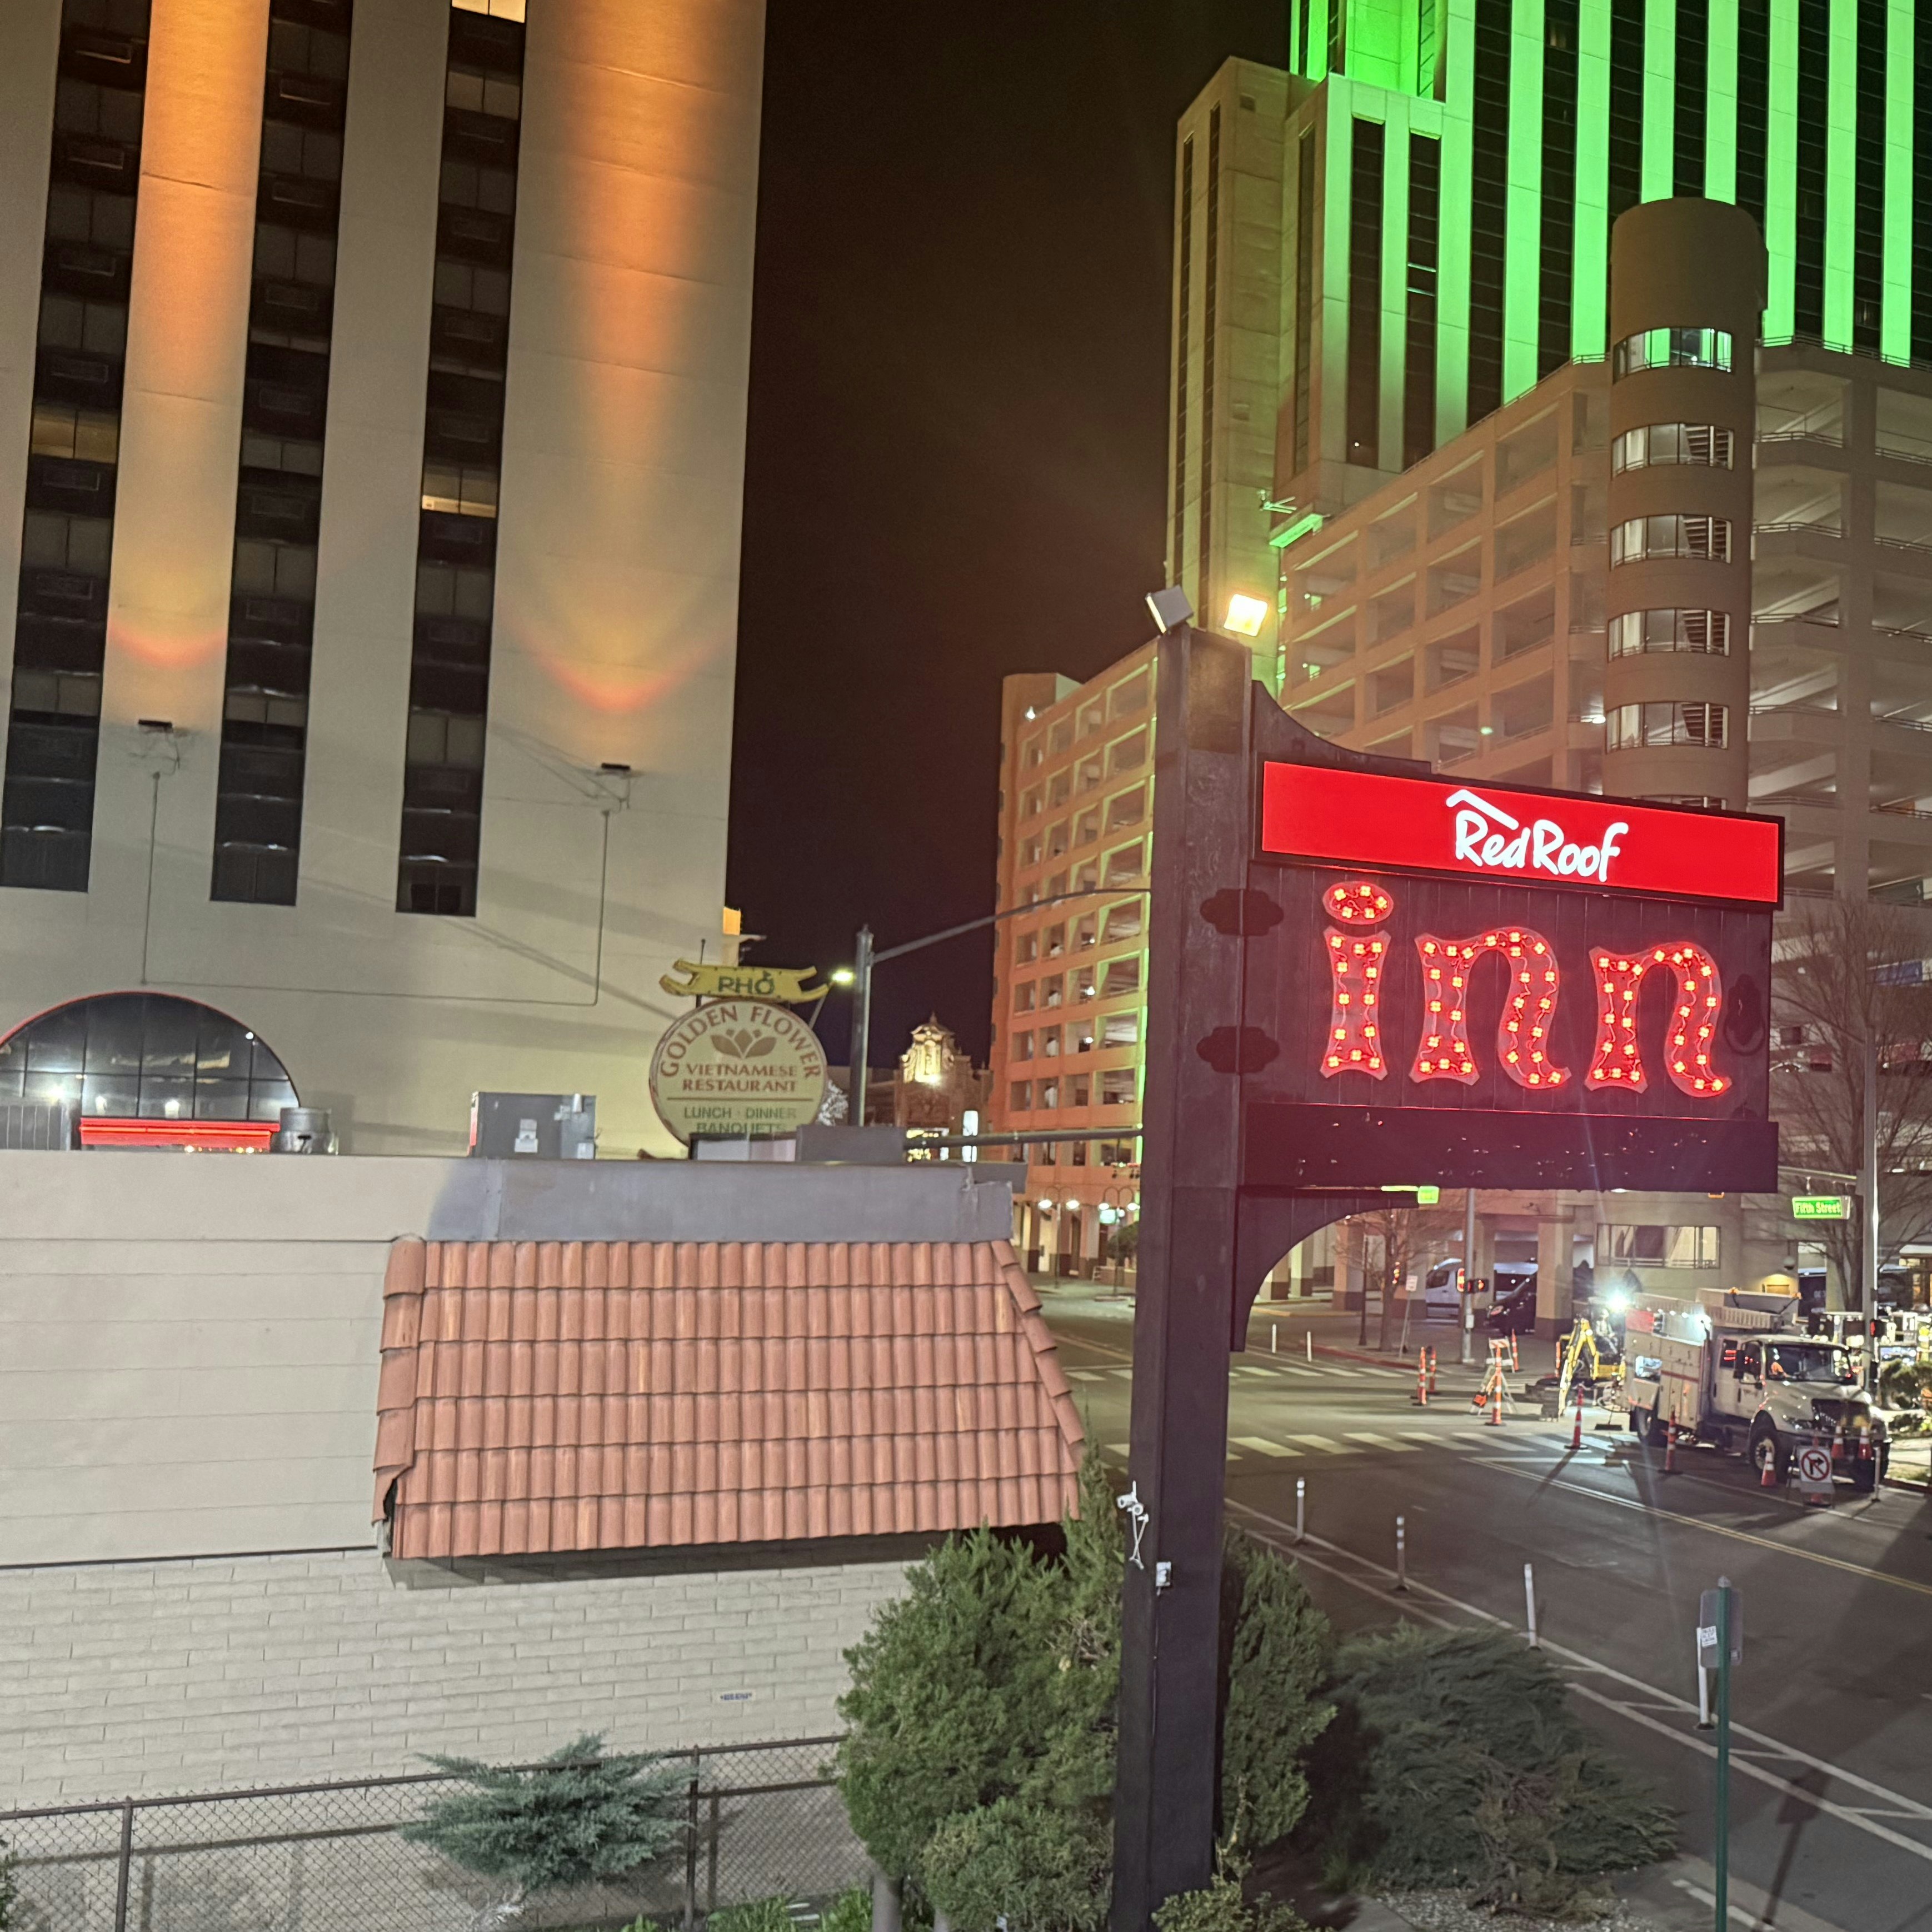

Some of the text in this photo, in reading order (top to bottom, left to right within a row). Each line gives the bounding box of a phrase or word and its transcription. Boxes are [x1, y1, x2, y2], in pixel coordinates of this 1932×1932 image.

[1320, 881, 1733, 1098] inn
[660, 1005, 821, 1080] GOLDEN FLOWER
[686, 1064, 797, 1076] VIETNAMESE
[682, 1080, 798, 1092] RESTAURANT
[684, 1107, 796, 1119] LUNCH DINNER
[1816, 1201, 1841, 1214] Street
